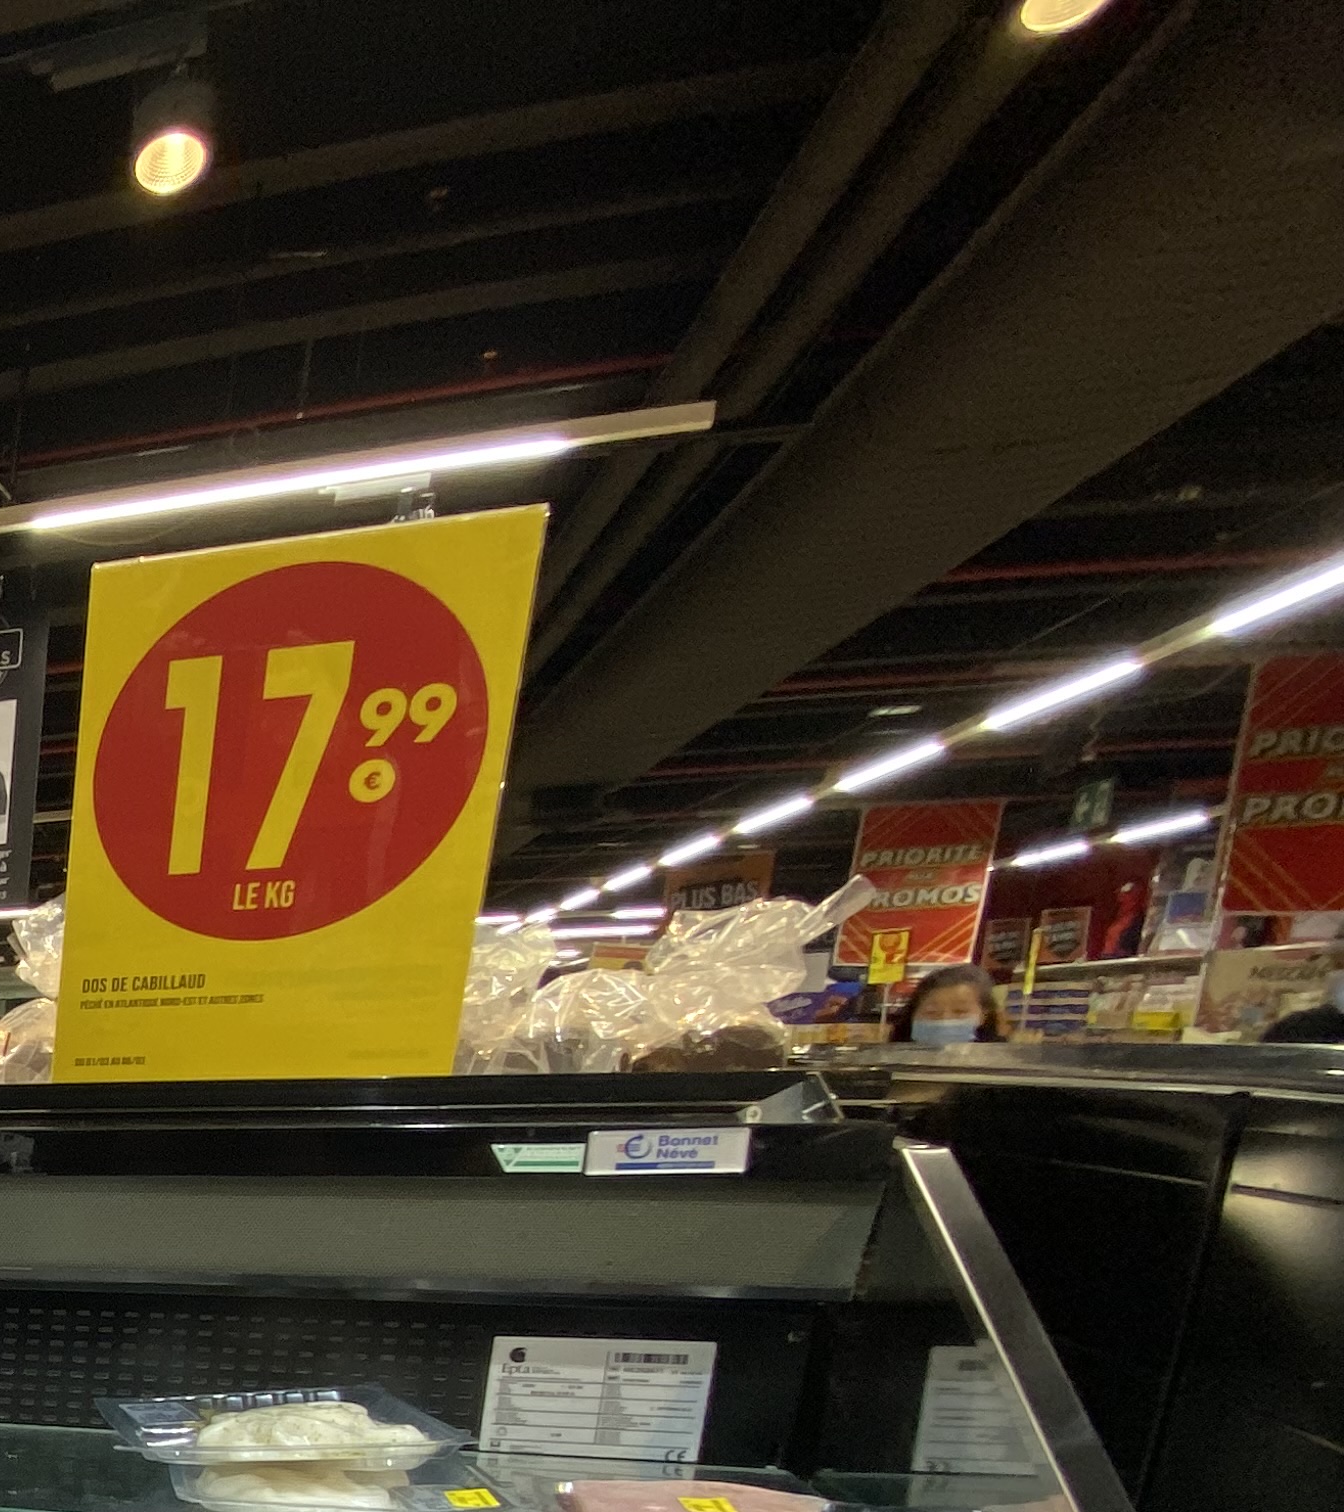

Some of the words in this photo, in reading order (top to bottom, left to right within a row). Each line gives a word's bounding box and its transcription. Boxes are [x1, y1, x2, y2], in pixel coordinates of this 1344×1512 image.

[165, 641, 355, 875] 17
[360, 683, 457, 747] 99
[1242, 793, 1344, 821] PRO
[233, 882, 260, 910] LE
[264, 880, 296, 908] KG
[720, 881, 759, 902] BAS
[871, 884, 982, 908] ROMOS
[82, 978, 108, 994] DOS
[112, 977, 128, 992] DE
[132, 974, 206, 991] CABILLAUD
[658, 1135, 718, 1147] Bonnet
[656, 1147, 698, 1158] Névé
